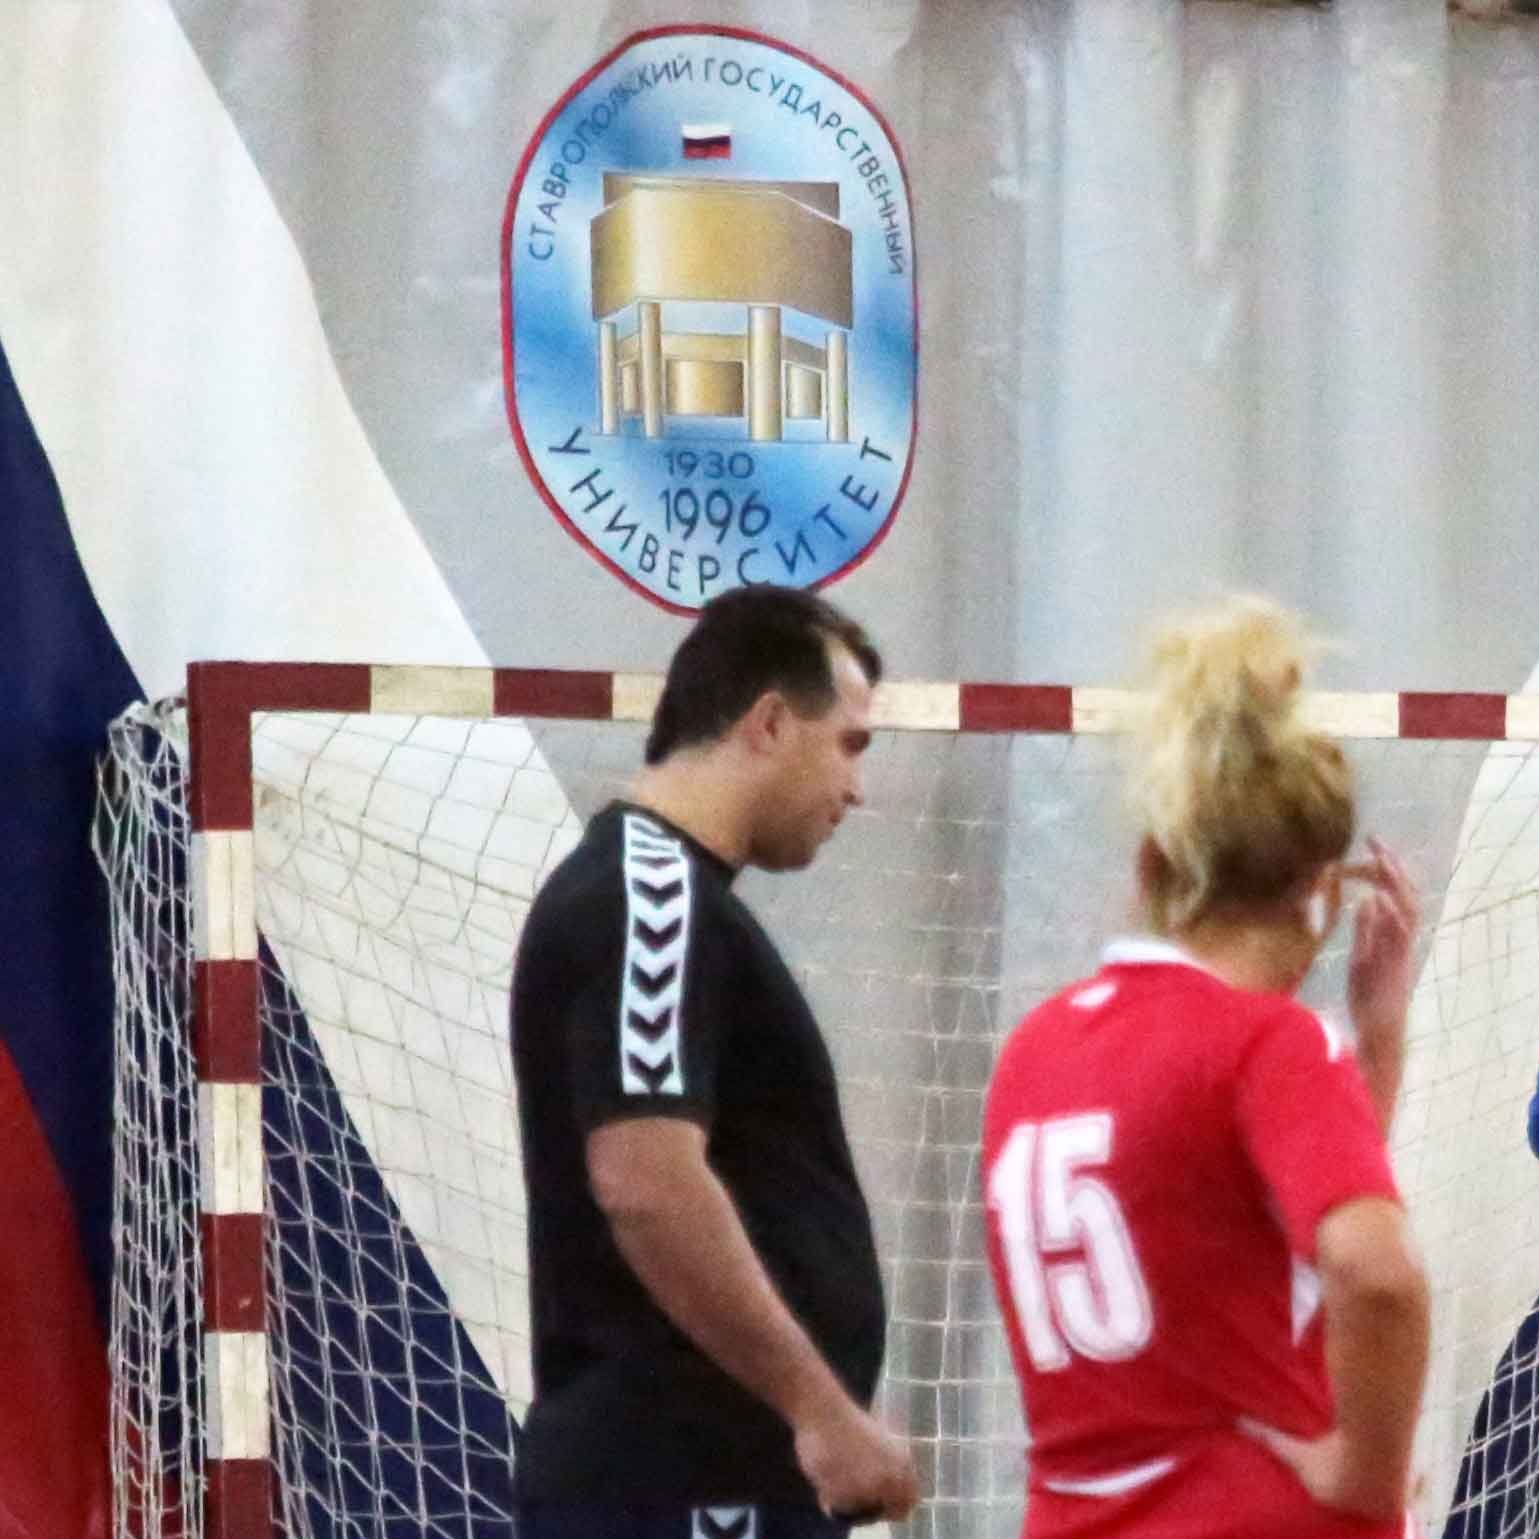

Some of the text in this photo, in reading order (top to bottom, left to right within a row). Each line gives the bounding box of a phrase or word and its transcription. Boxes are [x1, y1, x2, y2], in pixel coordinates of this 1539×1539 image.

[704, 57, 906, 275] ГОСУДАРСТВЕННЫЙ
[547, 426, 893, 594] УНИВЕРСИТЕТ
[659, 486, 772, 544] 1996
[664, 450, 755, 480] 1930
[990, 1111, 1154, 1373] 15
